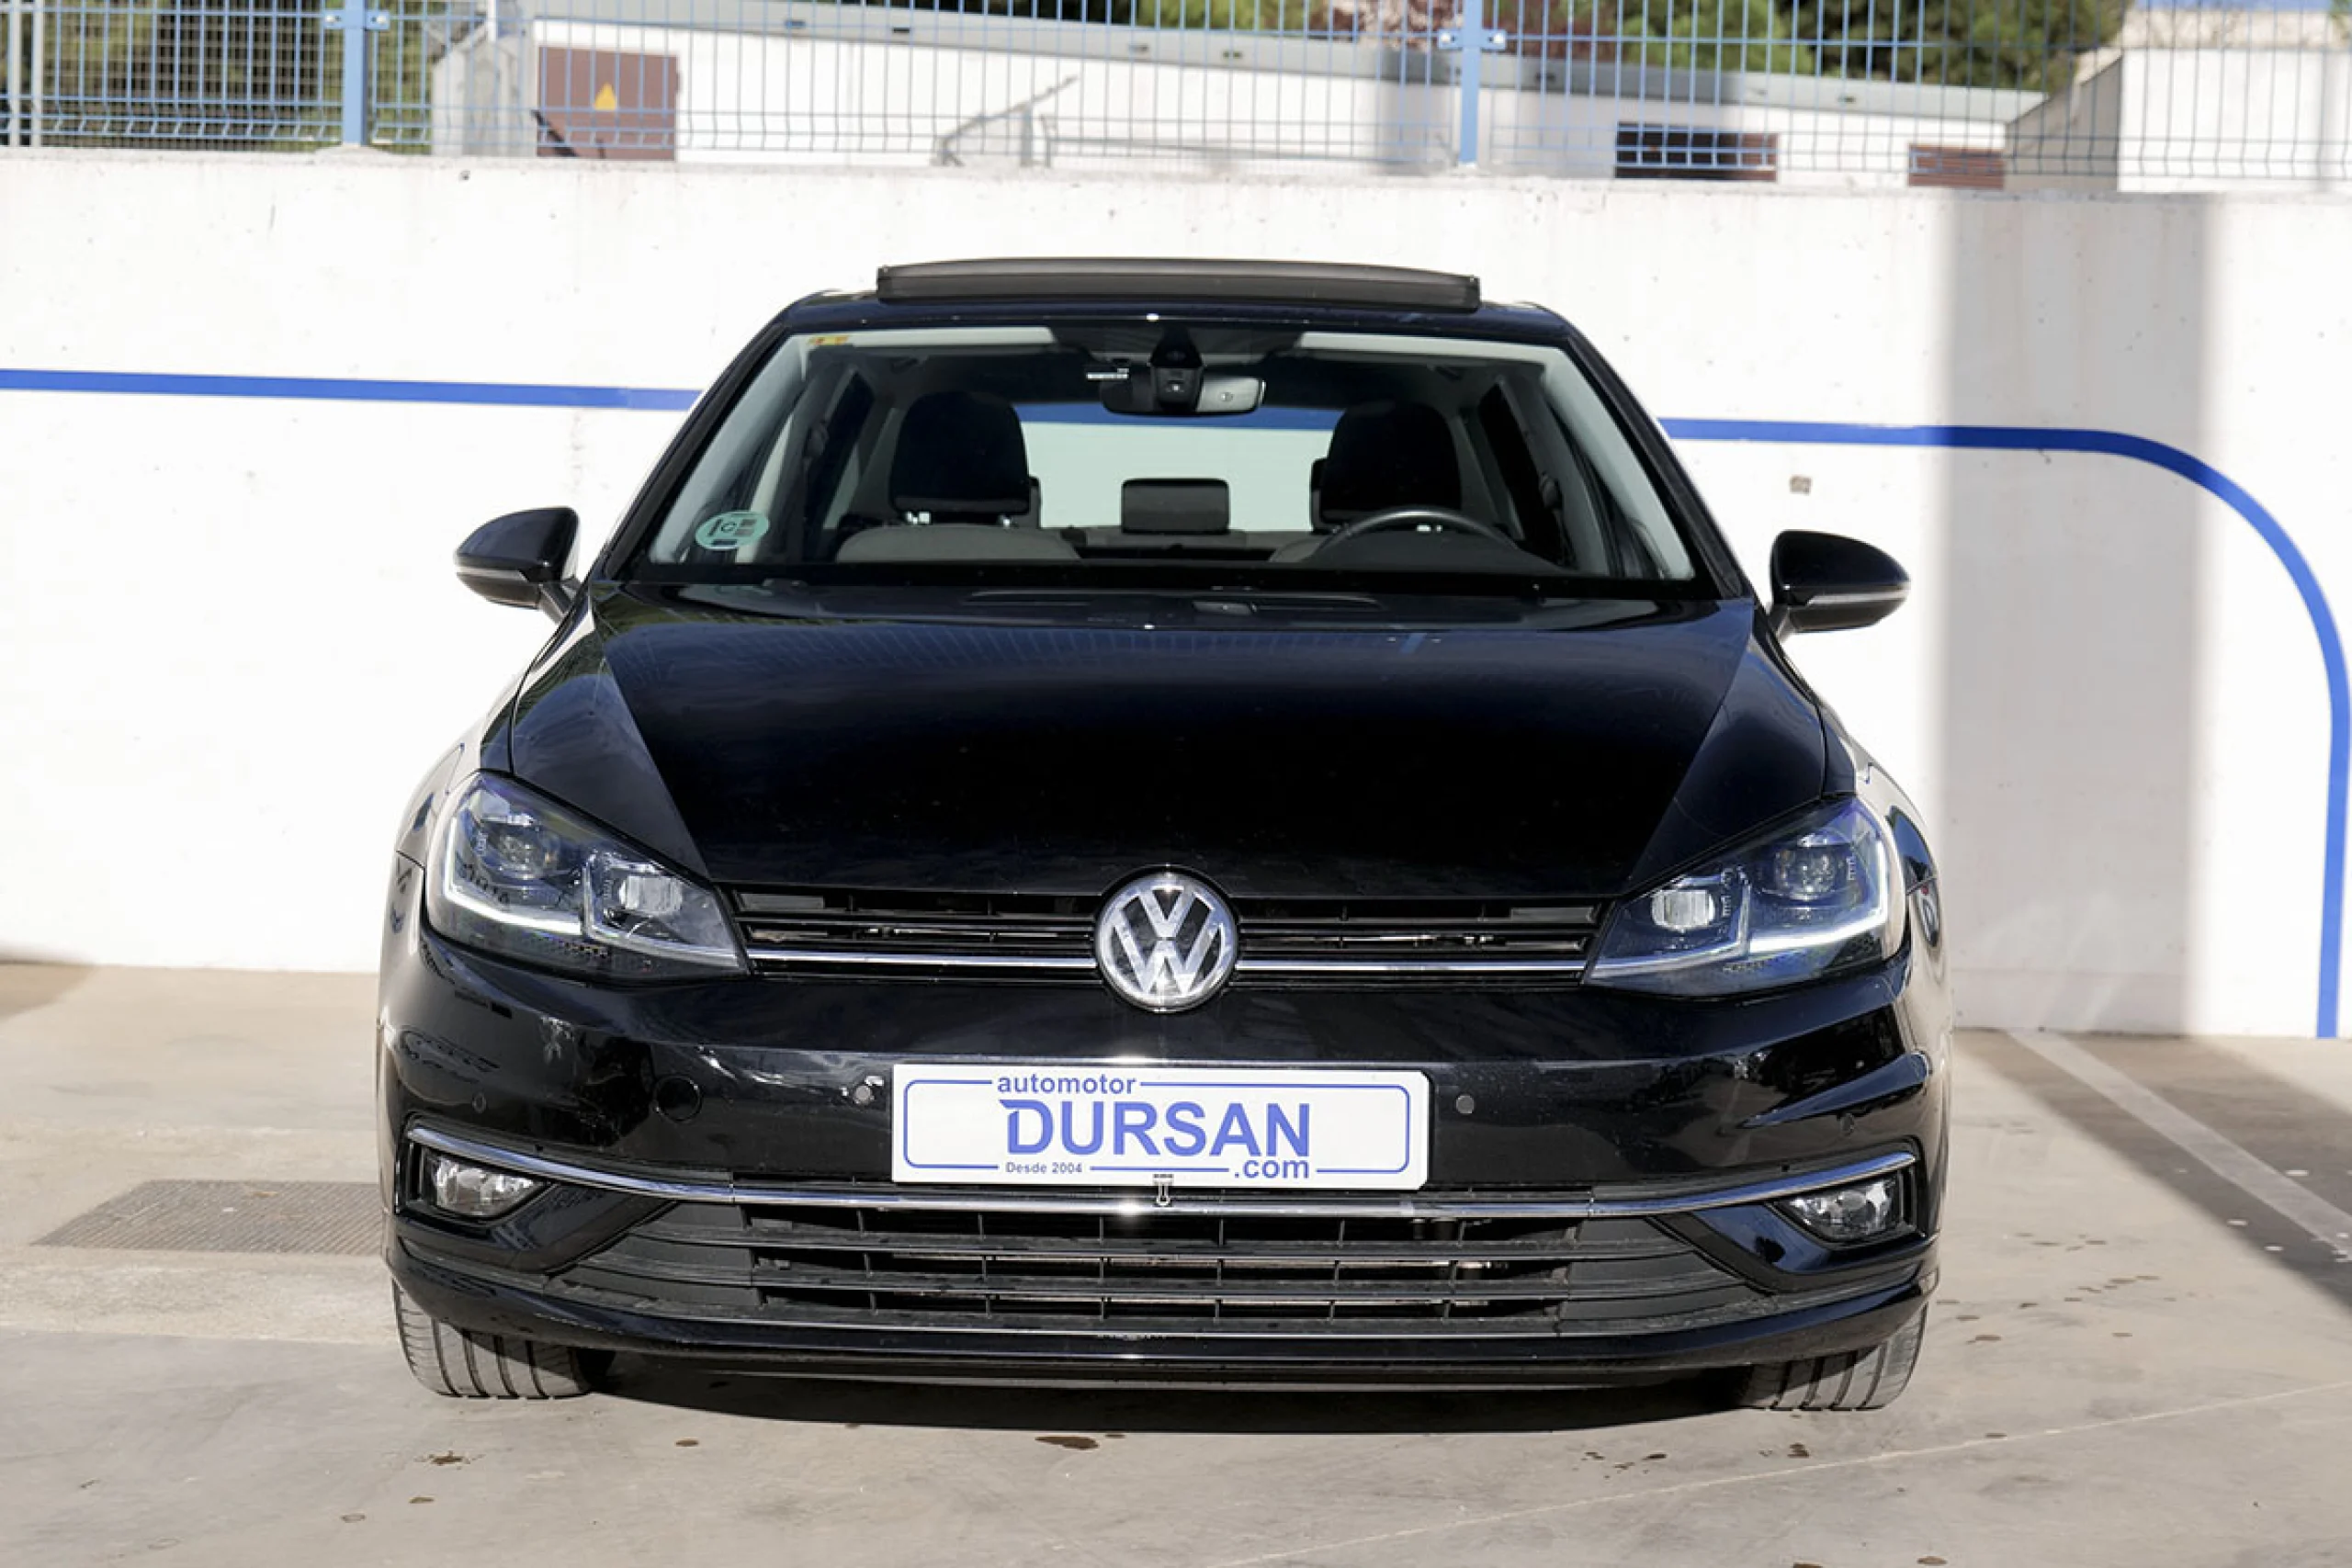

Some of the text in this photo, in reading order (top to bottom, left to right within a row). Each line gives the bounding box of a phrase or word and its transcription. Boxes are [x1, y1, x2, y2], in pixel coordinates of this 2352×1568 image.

[997, 1074, 1136, 1094] automotor
[999, 1099, 1310, 1157] DURSAN
[1005, 1161, 1082, 1174] Desde 2004
[1234, 1159, 1310, 1179] .com
